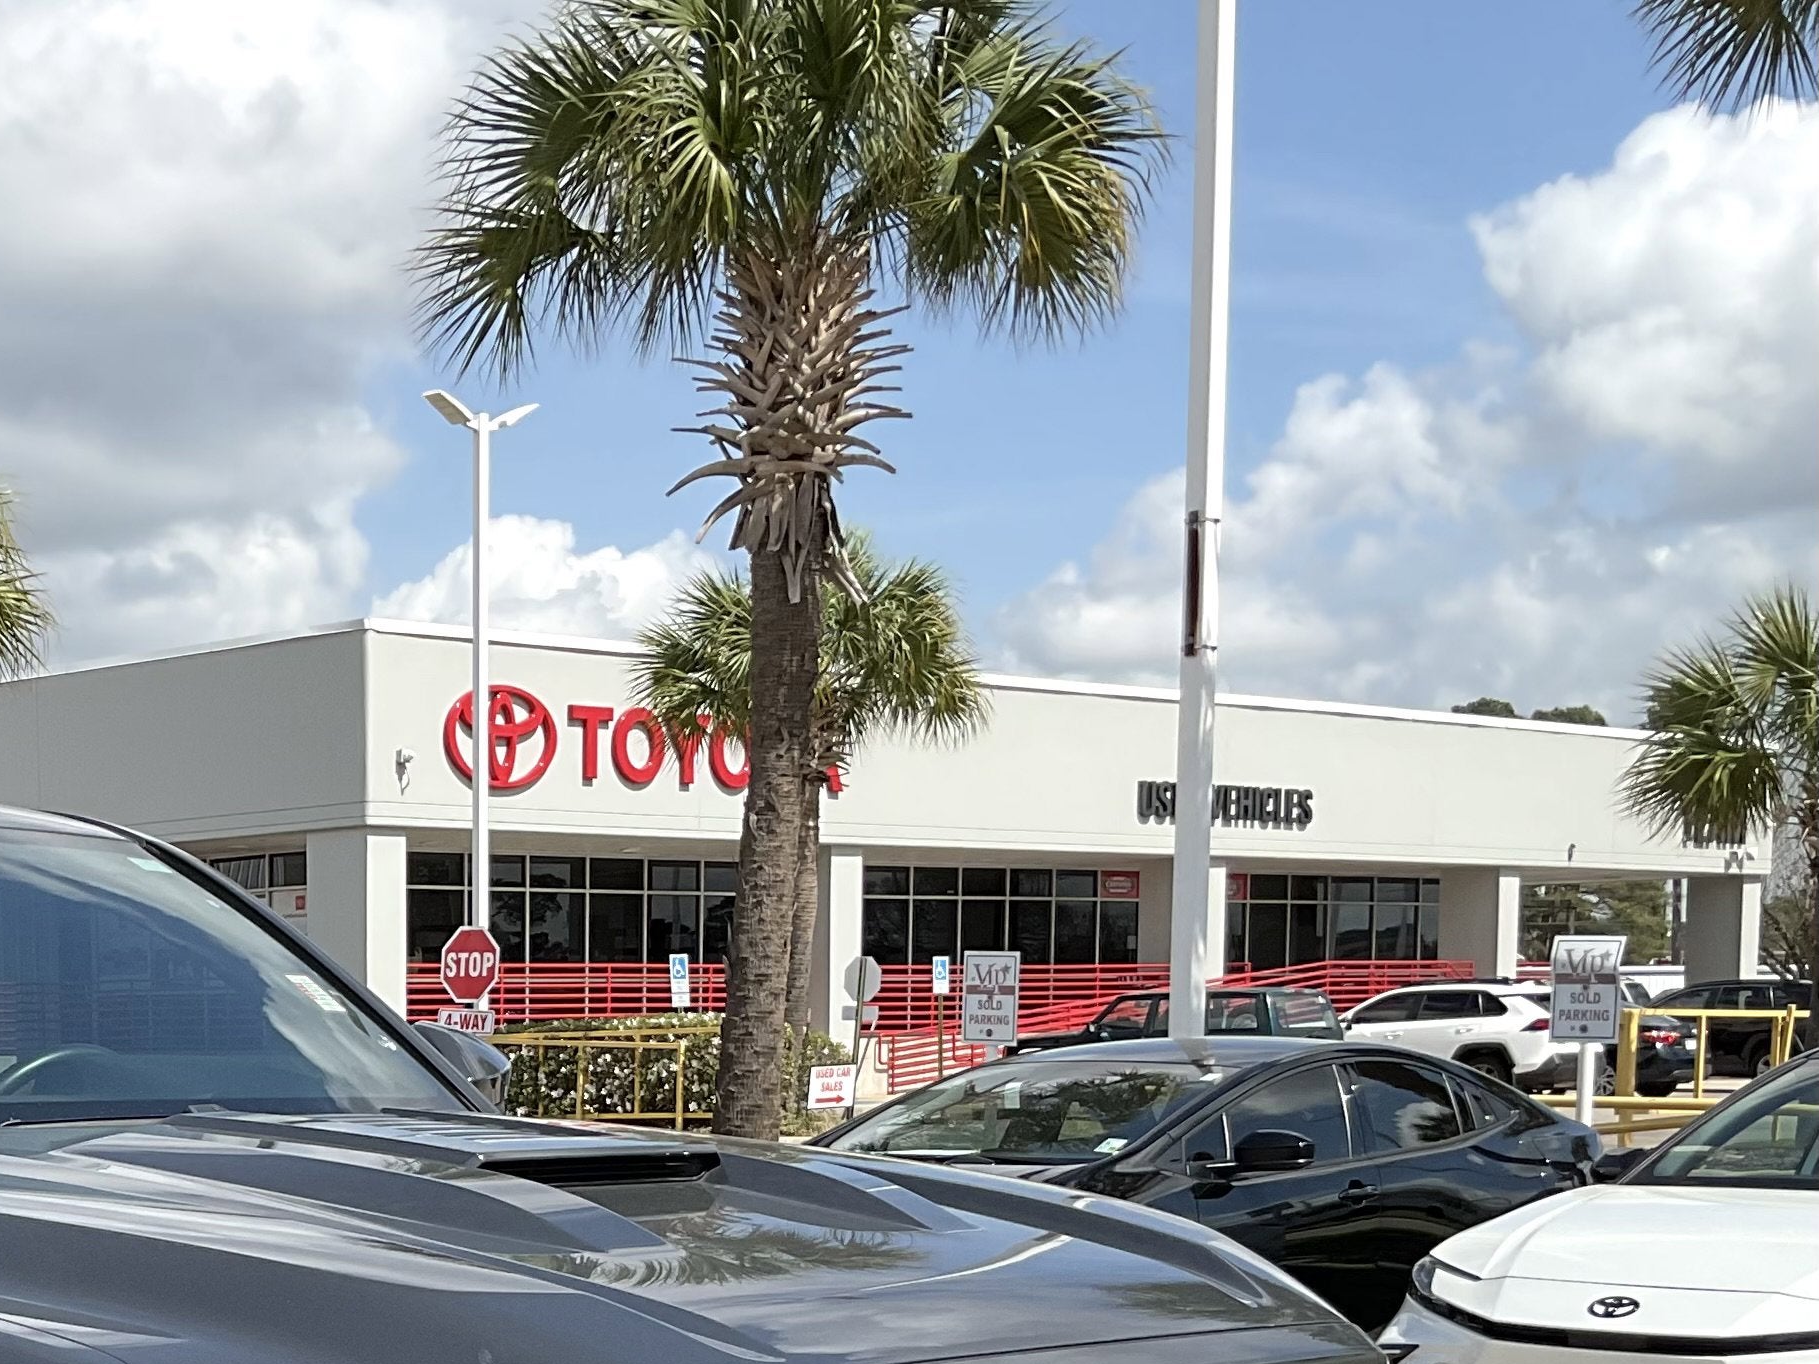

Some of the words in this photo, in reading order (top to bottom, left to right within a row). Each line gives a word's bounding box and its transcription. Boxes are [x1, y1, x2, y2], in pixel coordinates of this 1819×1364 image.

[445, 951, 495, 978] STOP
[1570, 992, 1602, 1004] SOLD
[977, 1000, 1003, 1010] SOLD
[968, 1014, 1011, 1026] PARKING
[1559, 1009, 1611, 1022] PARKING
[444, 1013, 488, 1032] 4-WAY
[815, 1068, 835, 1079] USED
[836, 1066, 851, 1078] CAR
[821, 1081, 844, 1092] SALES
